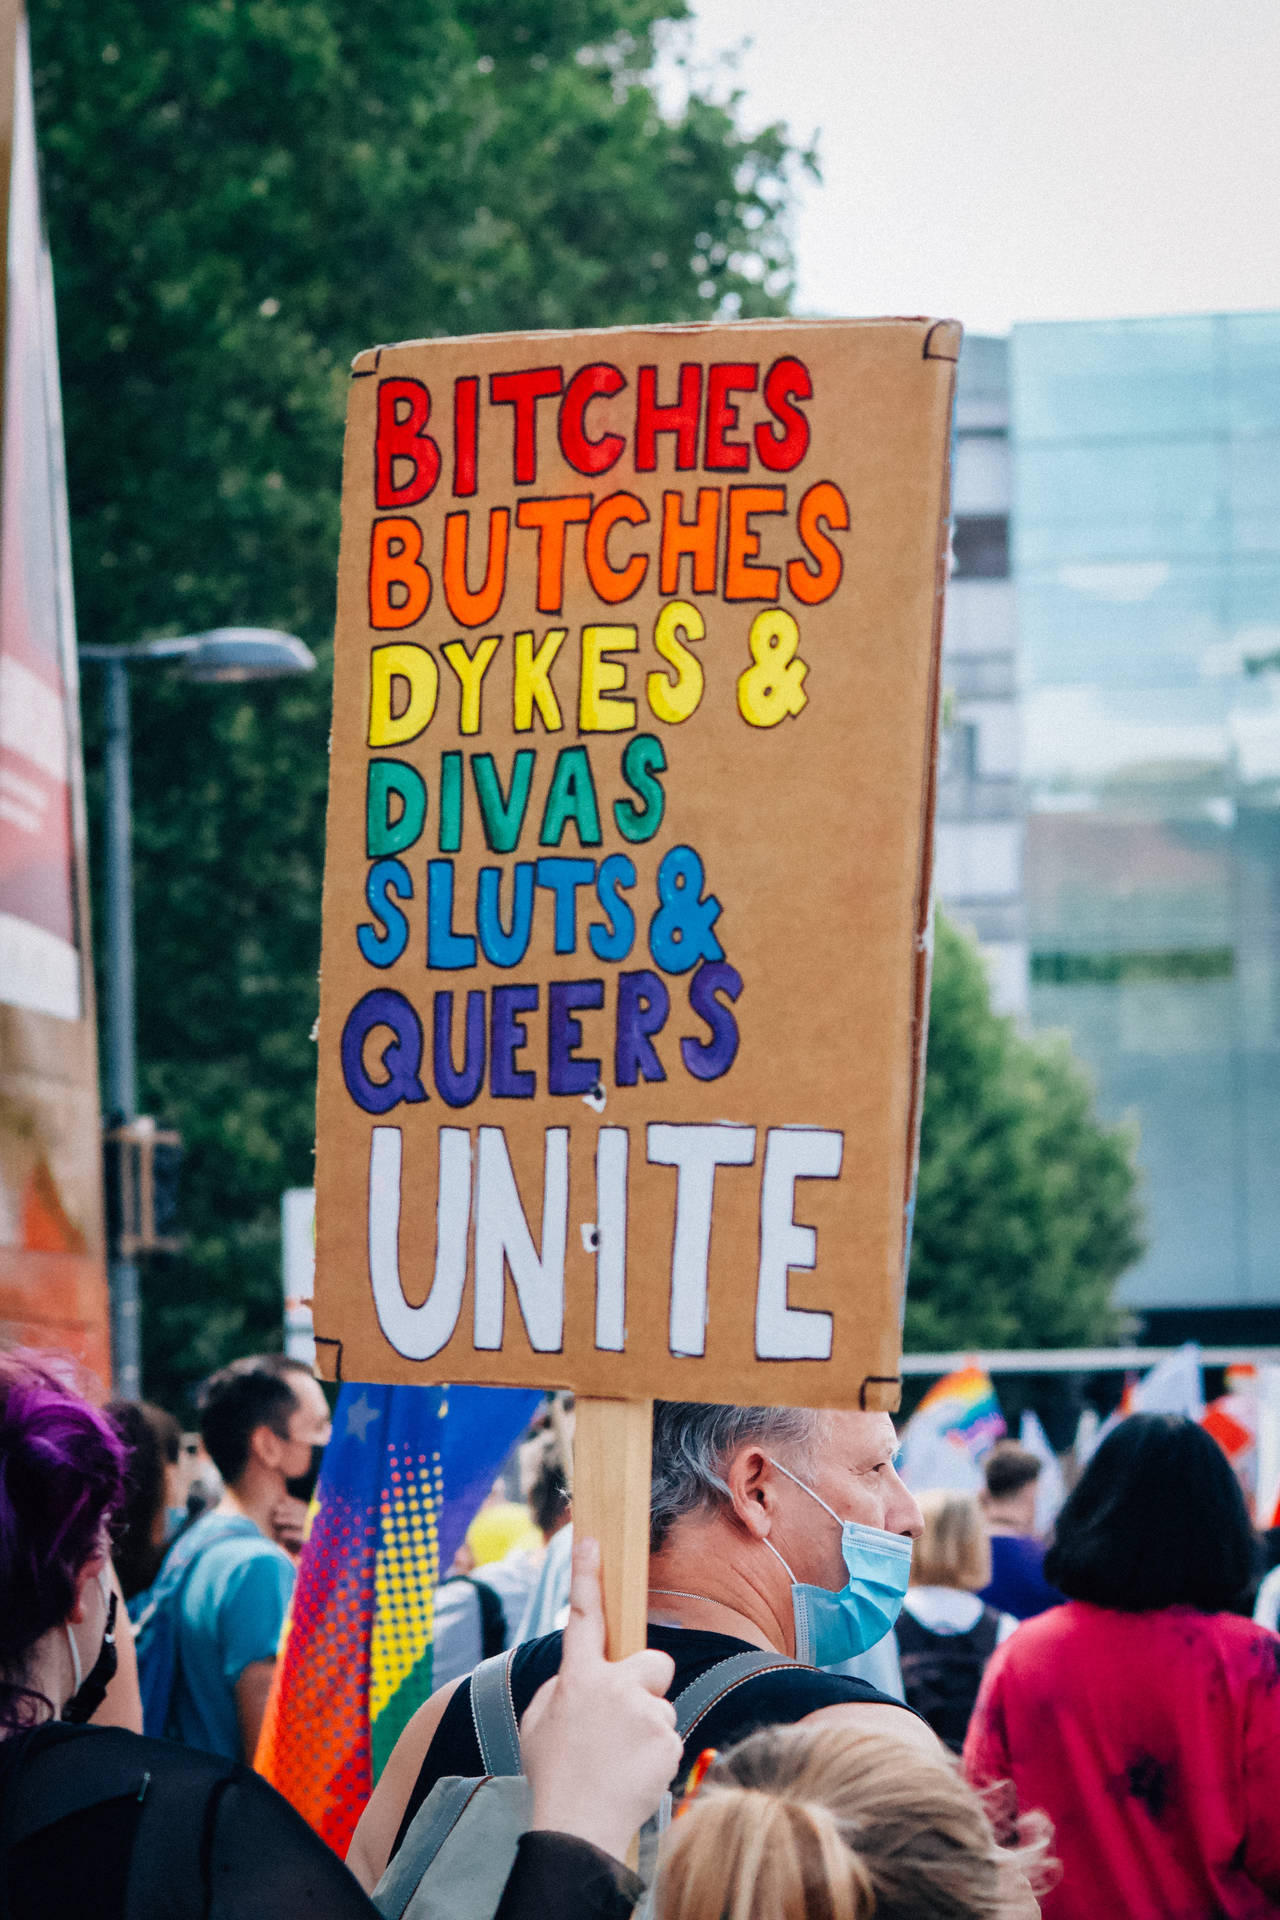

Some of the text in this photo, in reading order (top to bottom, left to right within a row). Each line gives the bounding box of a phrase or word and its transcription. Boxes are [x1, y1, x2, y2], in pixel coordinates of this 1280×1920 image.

[374, 355, 813, 510] BITCHES
[368, 480, 850, 630] BUTCHES
[367, 600, 810, 748] DYKES &
[366, 733, 668, 859] DIVAS
[340, 961, 745, 1115] QUEERS
[367, 1120, 845, 1362] UNITE
